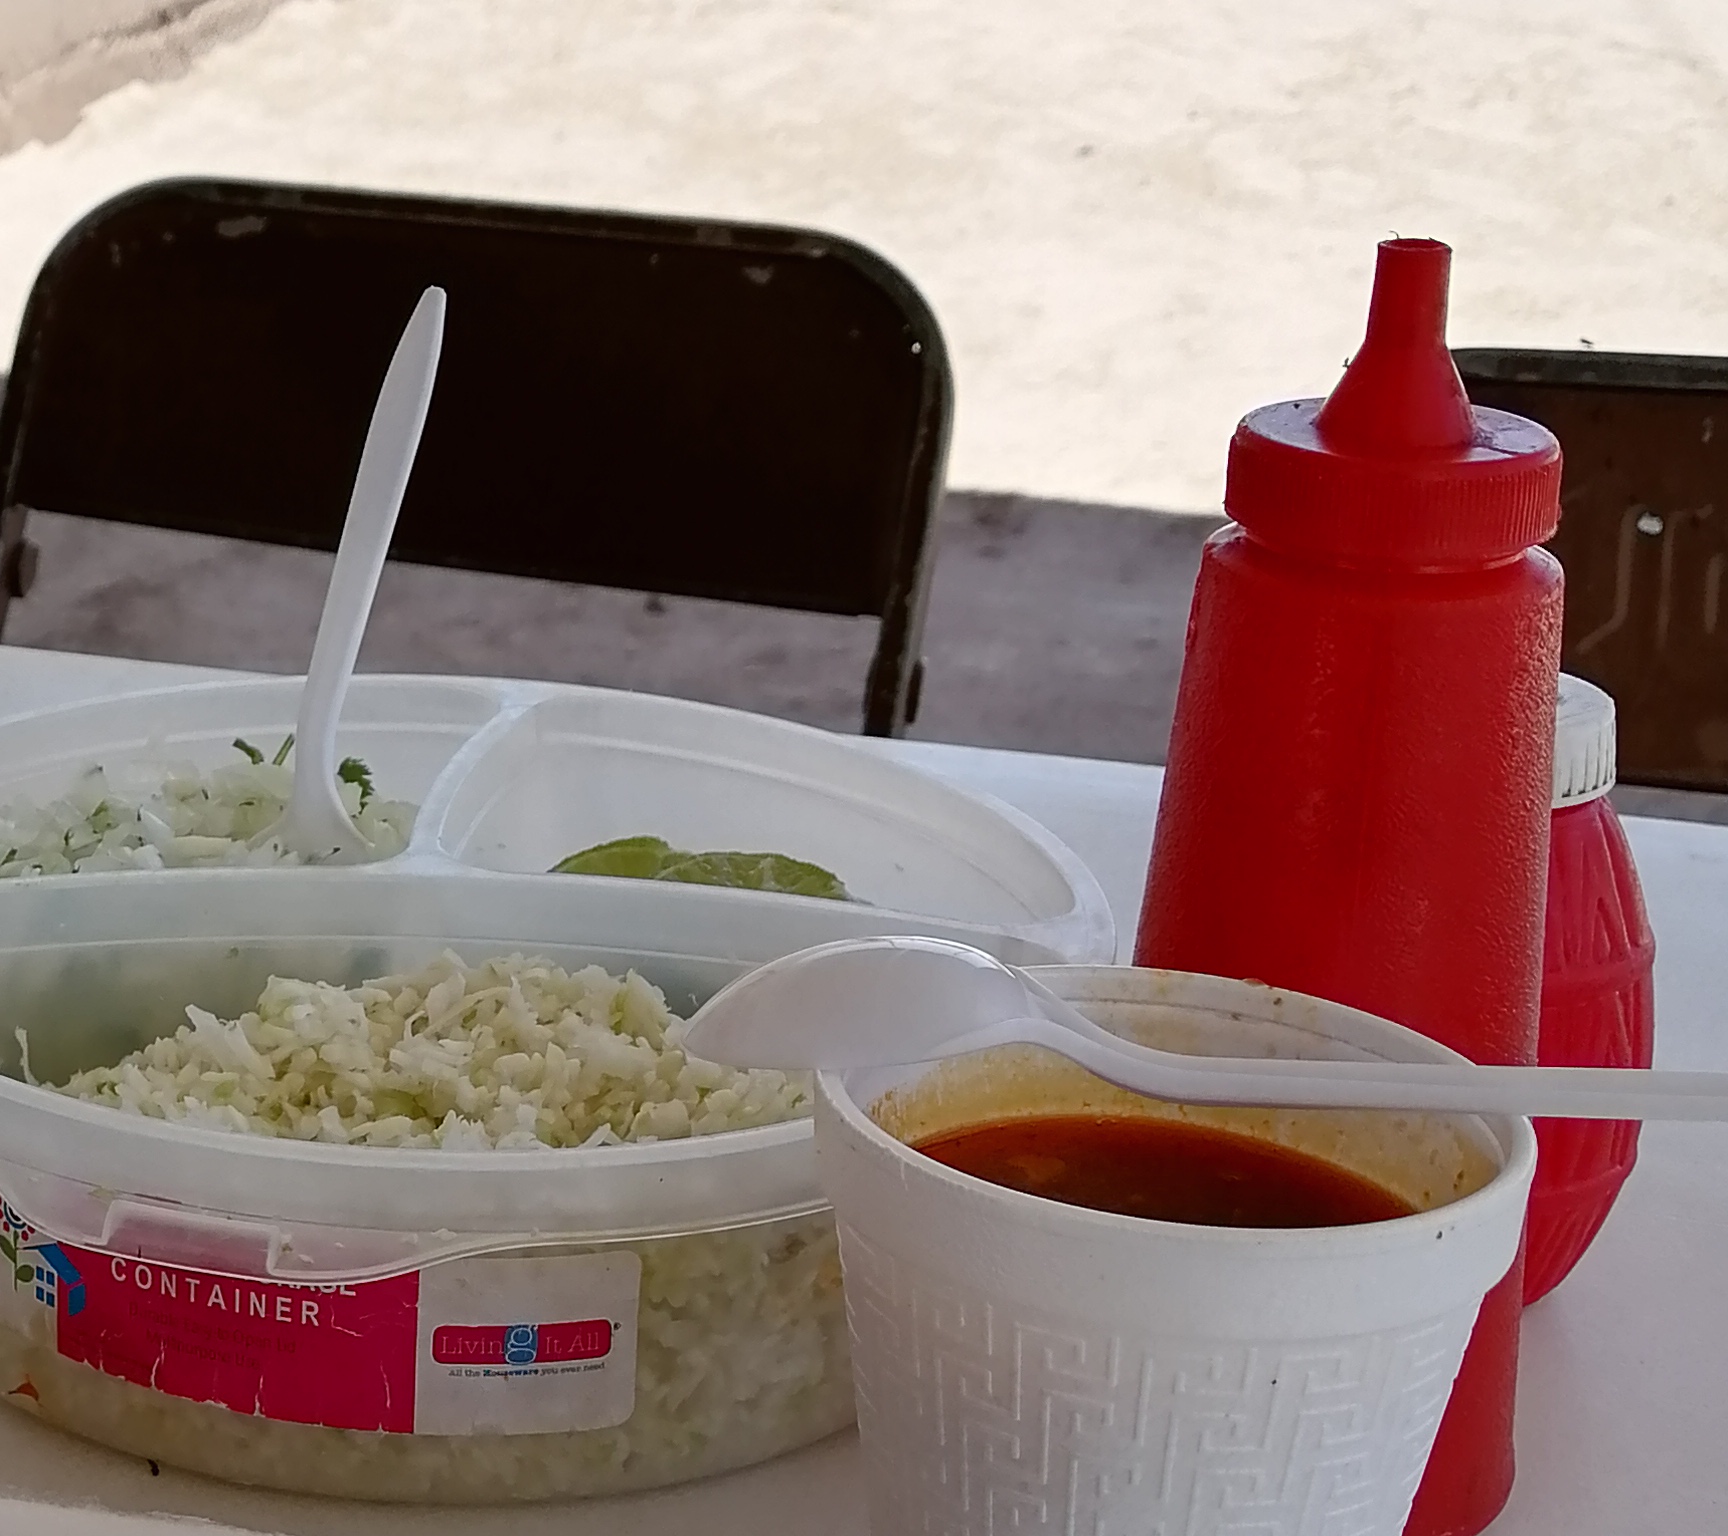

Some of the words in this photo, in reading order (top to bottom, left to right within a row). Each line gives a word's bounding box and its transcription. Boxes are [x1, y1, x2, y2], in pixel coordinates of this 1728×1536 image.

[110, 1257, 320, 1327] CONTAINER
[440, 1323, 539, 1364] Living
[545, 1336, 562, 1355] It
[568, 1330, 600, 1354] All
[540, 1368, 559, 1378] you
